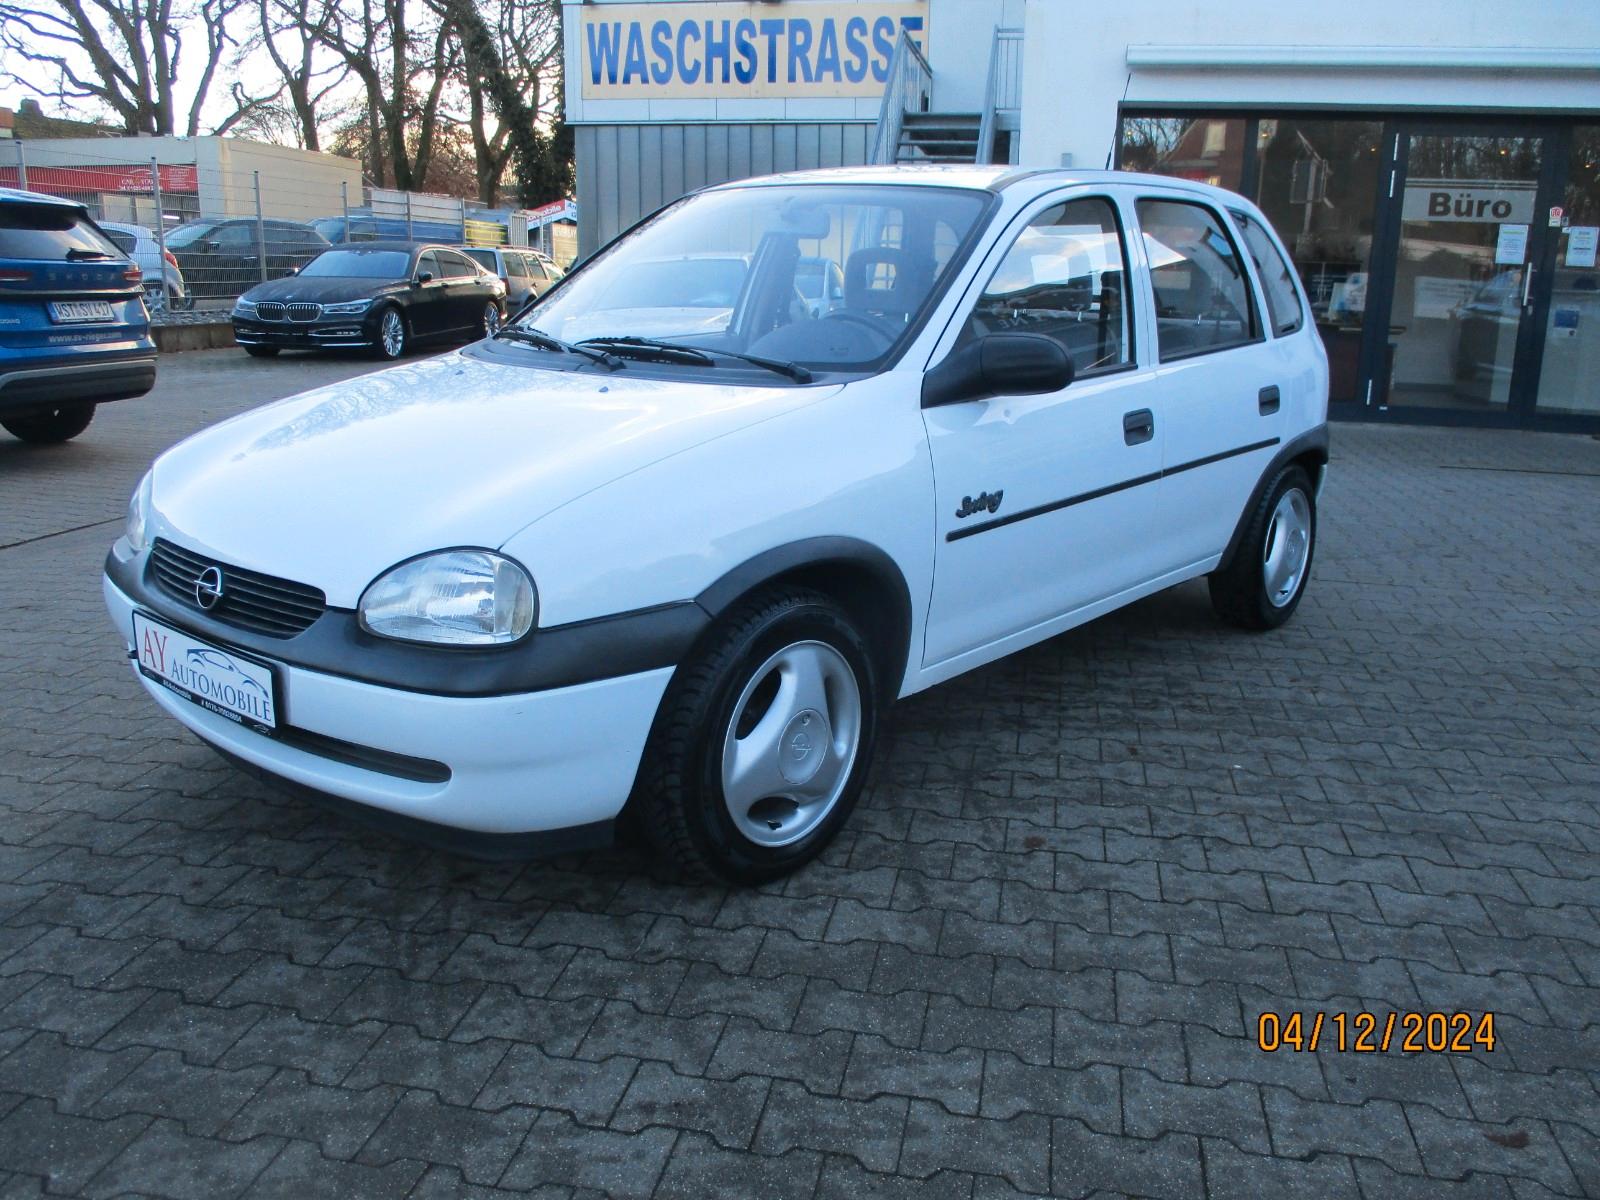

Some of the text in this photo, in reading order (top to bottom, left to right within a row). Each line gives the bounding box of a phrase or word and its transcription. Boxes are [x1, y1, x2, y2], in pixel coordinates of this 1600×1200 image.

[1428, 192, 1513, 219] Büro
[143, 626, 168, 673] AY
[171, 658, 272, 722] AUTOMOBILE
